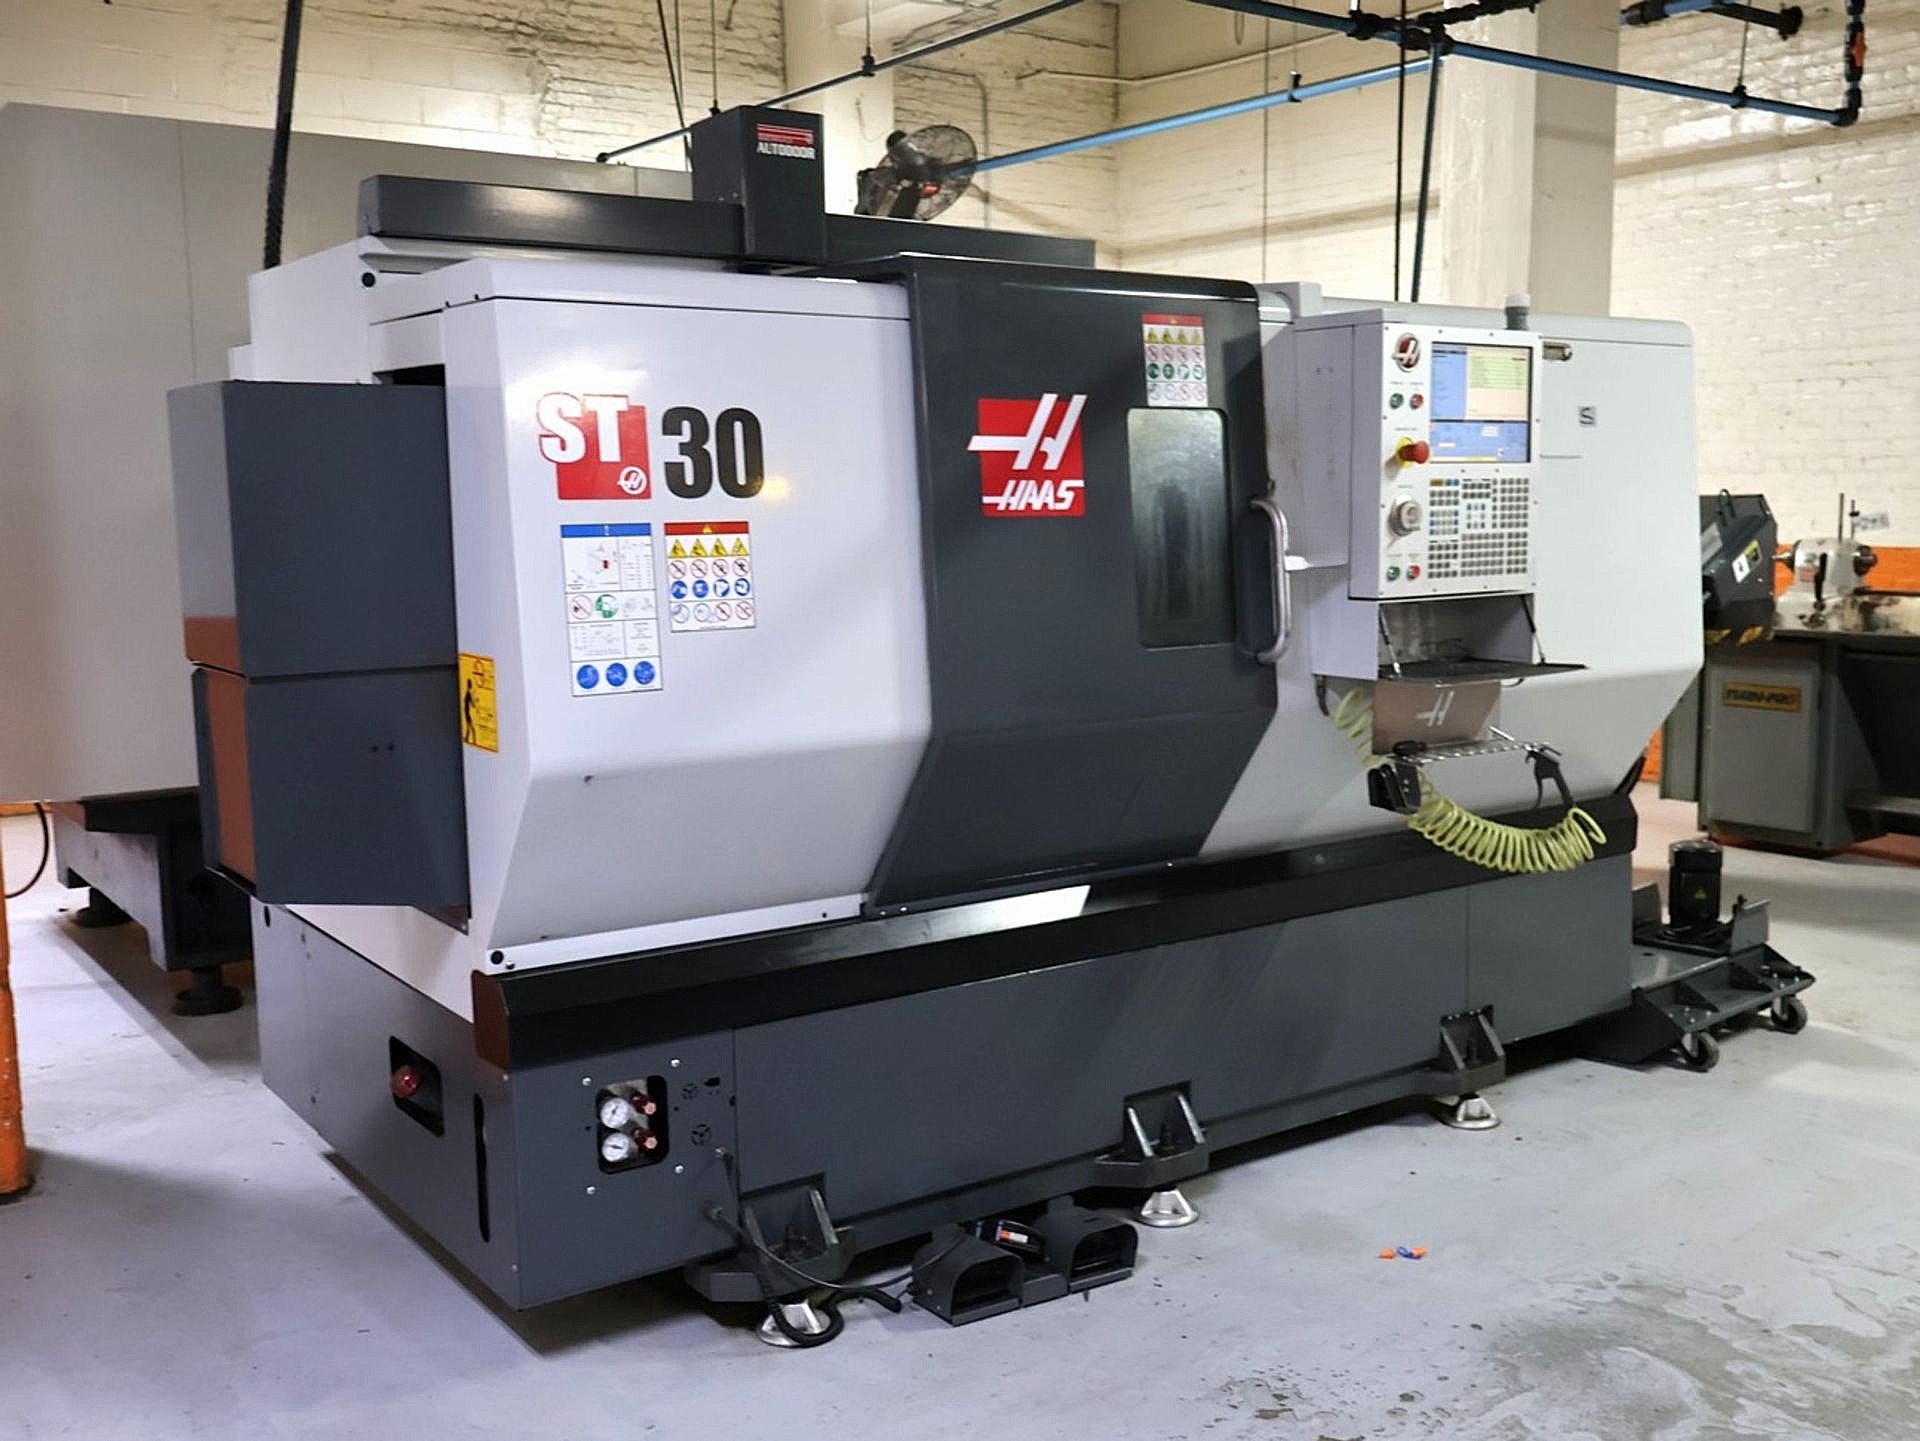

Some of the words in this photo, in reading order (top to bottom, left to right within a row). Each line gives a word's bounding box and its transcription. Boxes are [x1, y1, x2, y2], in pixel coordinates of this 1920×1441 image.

[537, 392, 629, 463] ST
[662, 406, 765, 498] 30
[982, 479, 1085, 511] HAAS
